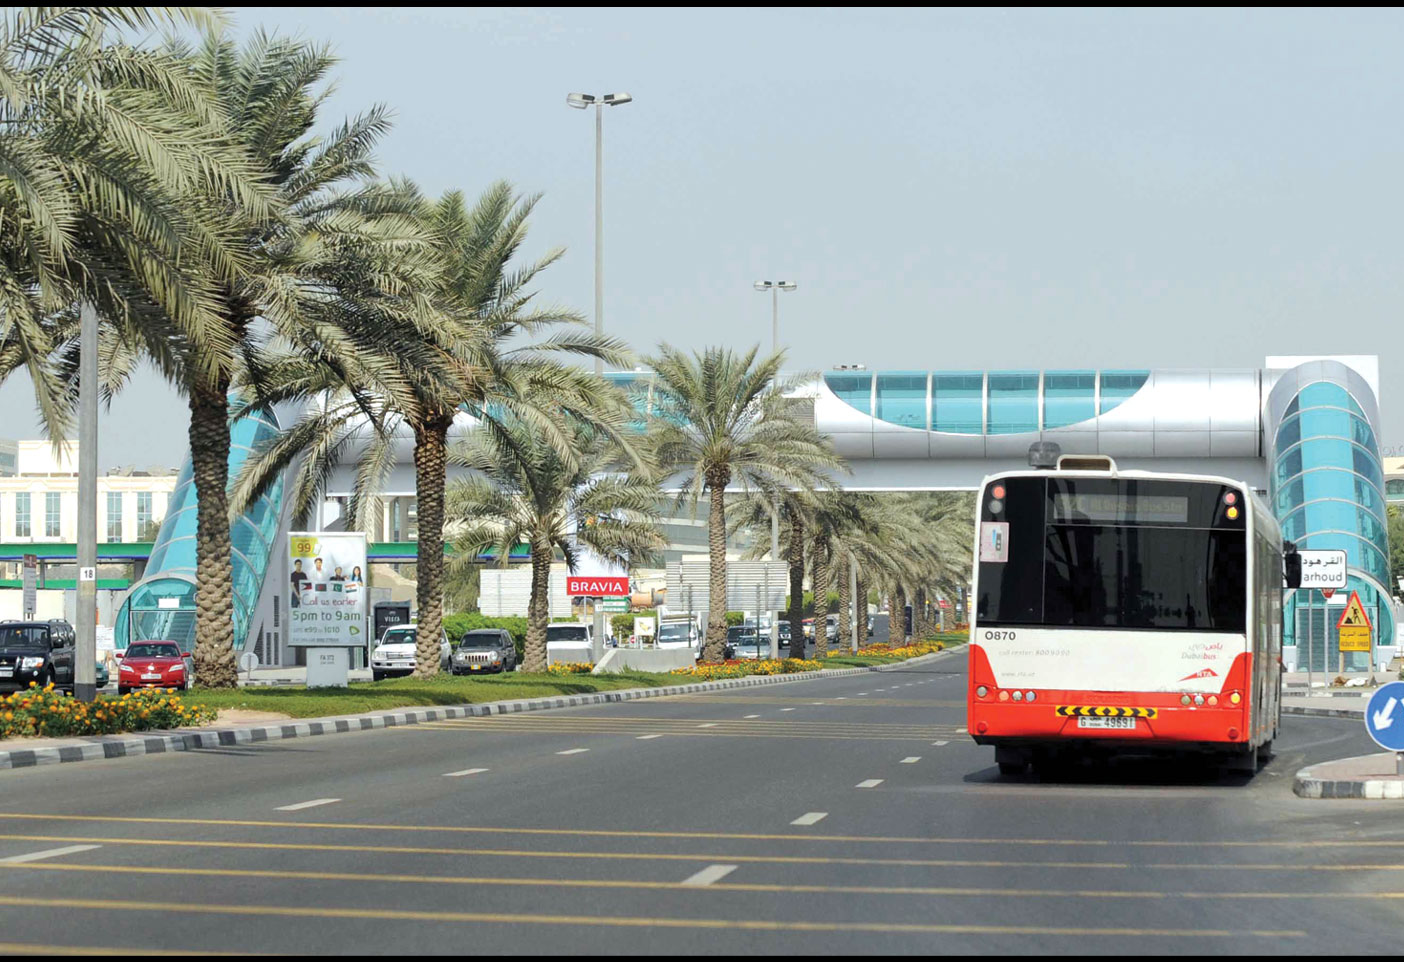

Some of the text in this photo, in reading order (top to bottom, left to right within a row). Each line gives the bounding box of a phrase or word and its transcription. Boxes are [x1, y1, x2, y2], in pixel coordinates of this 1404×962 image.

[297, 543, 311, 553] 99
[83, 569, 94, 579] 18
[1303, 572, 1343, 582] arhoud
[571, 581, 623, 592] BRAVIA
[292, 610, 318, 622] 5pm
[321, 611, 333, 621] to
